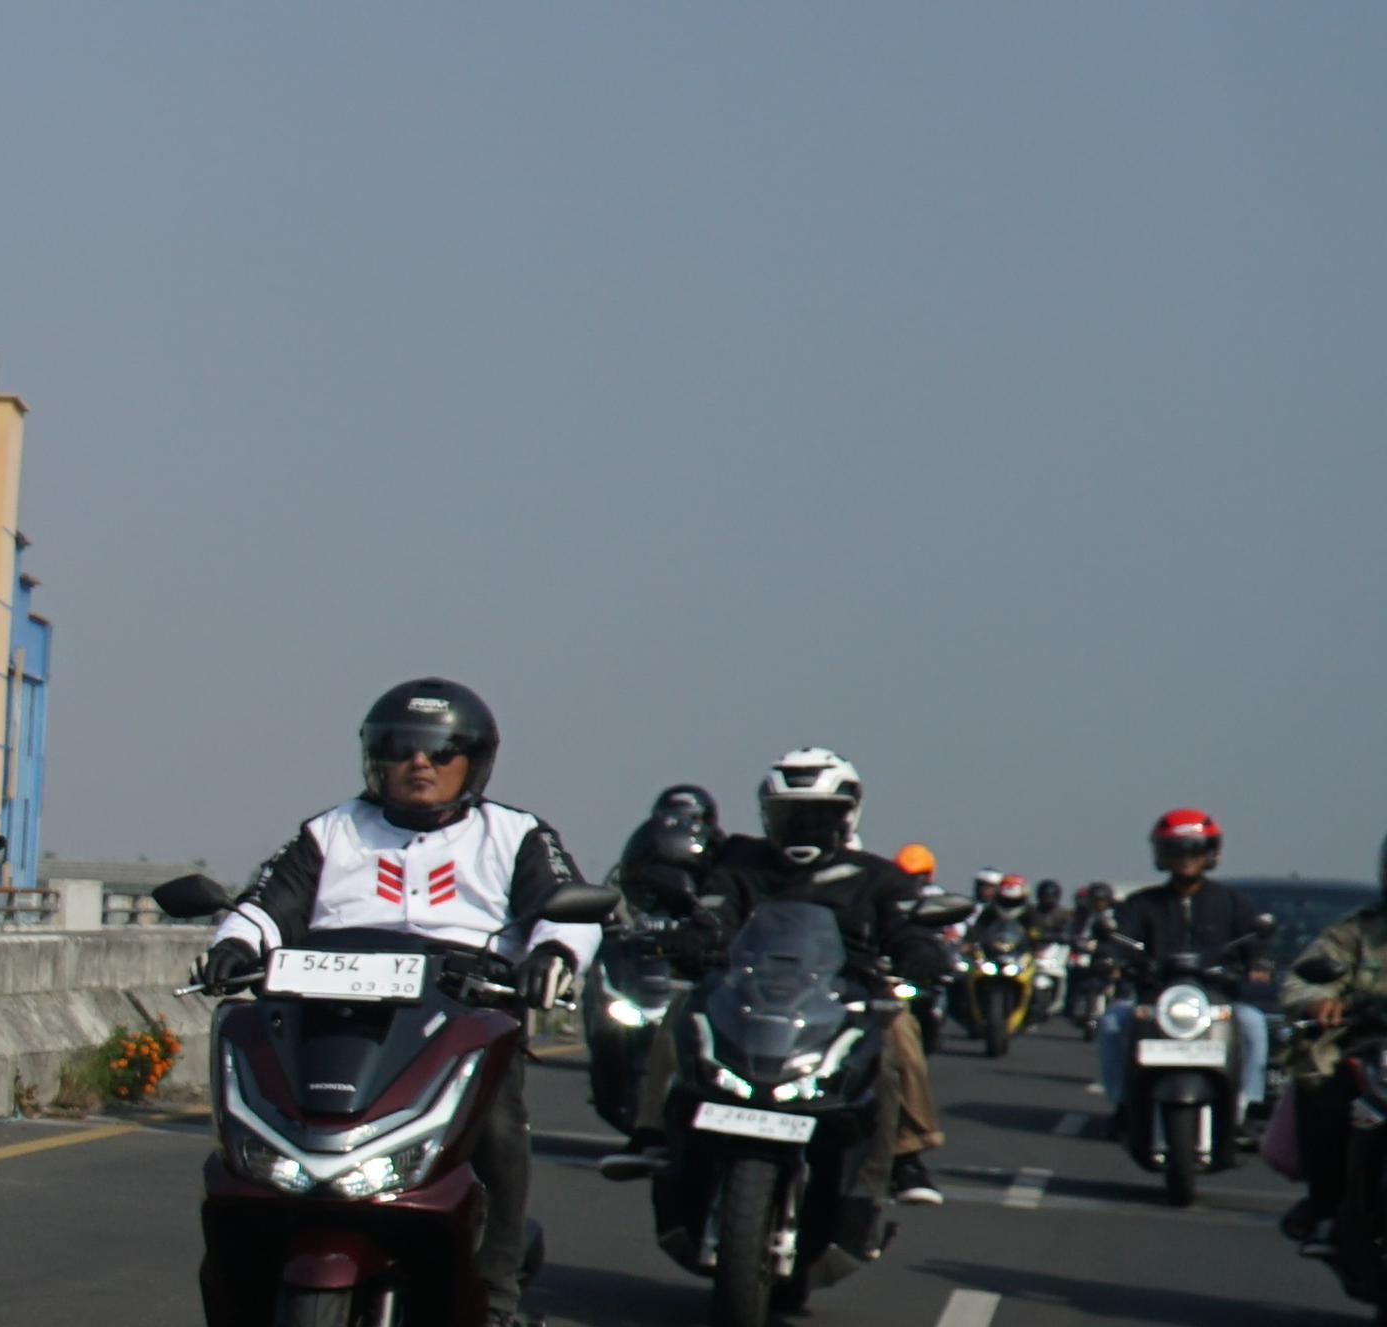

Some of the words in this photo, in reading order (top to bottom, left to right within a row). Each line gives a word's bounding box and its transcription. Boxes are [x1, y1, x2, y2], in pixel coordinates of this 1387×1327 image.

[277, 953, 290, 970] T
[302, 954, 360, 973] 5454
[393, 957, 420, 975] YZ
